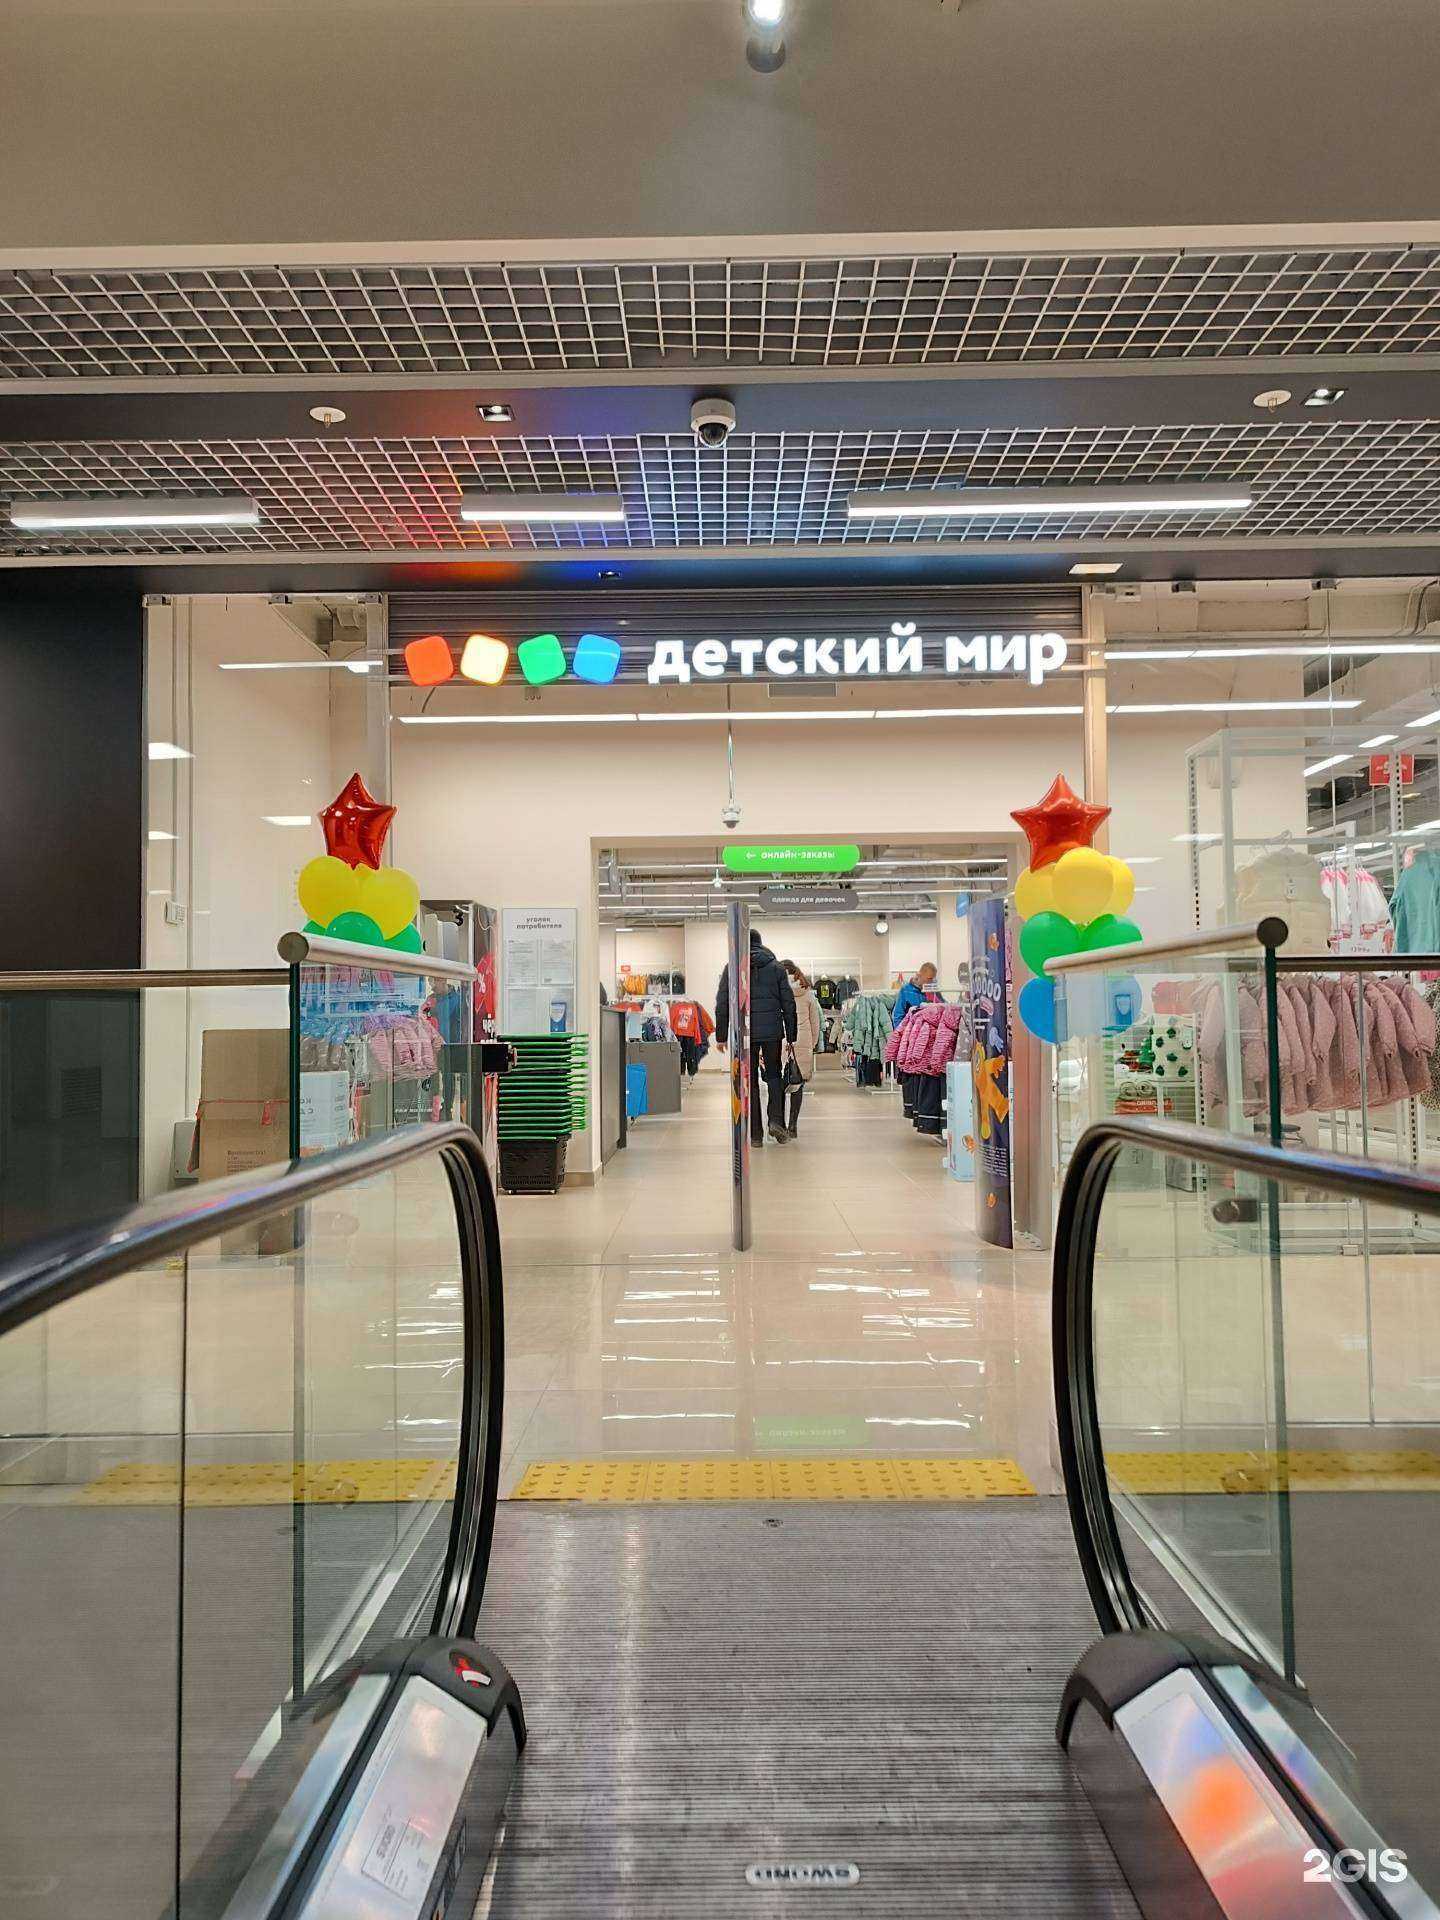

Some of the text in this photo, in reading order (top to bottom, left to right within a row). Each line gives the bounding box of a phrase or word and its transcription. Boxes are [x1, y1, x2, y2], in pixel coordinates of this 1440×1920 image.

[647, 622, 1069, 686] детский мир
[761, 849, 836, 859] онлайн-заказы
[772, 895, 846, 904] одежда для девочек
